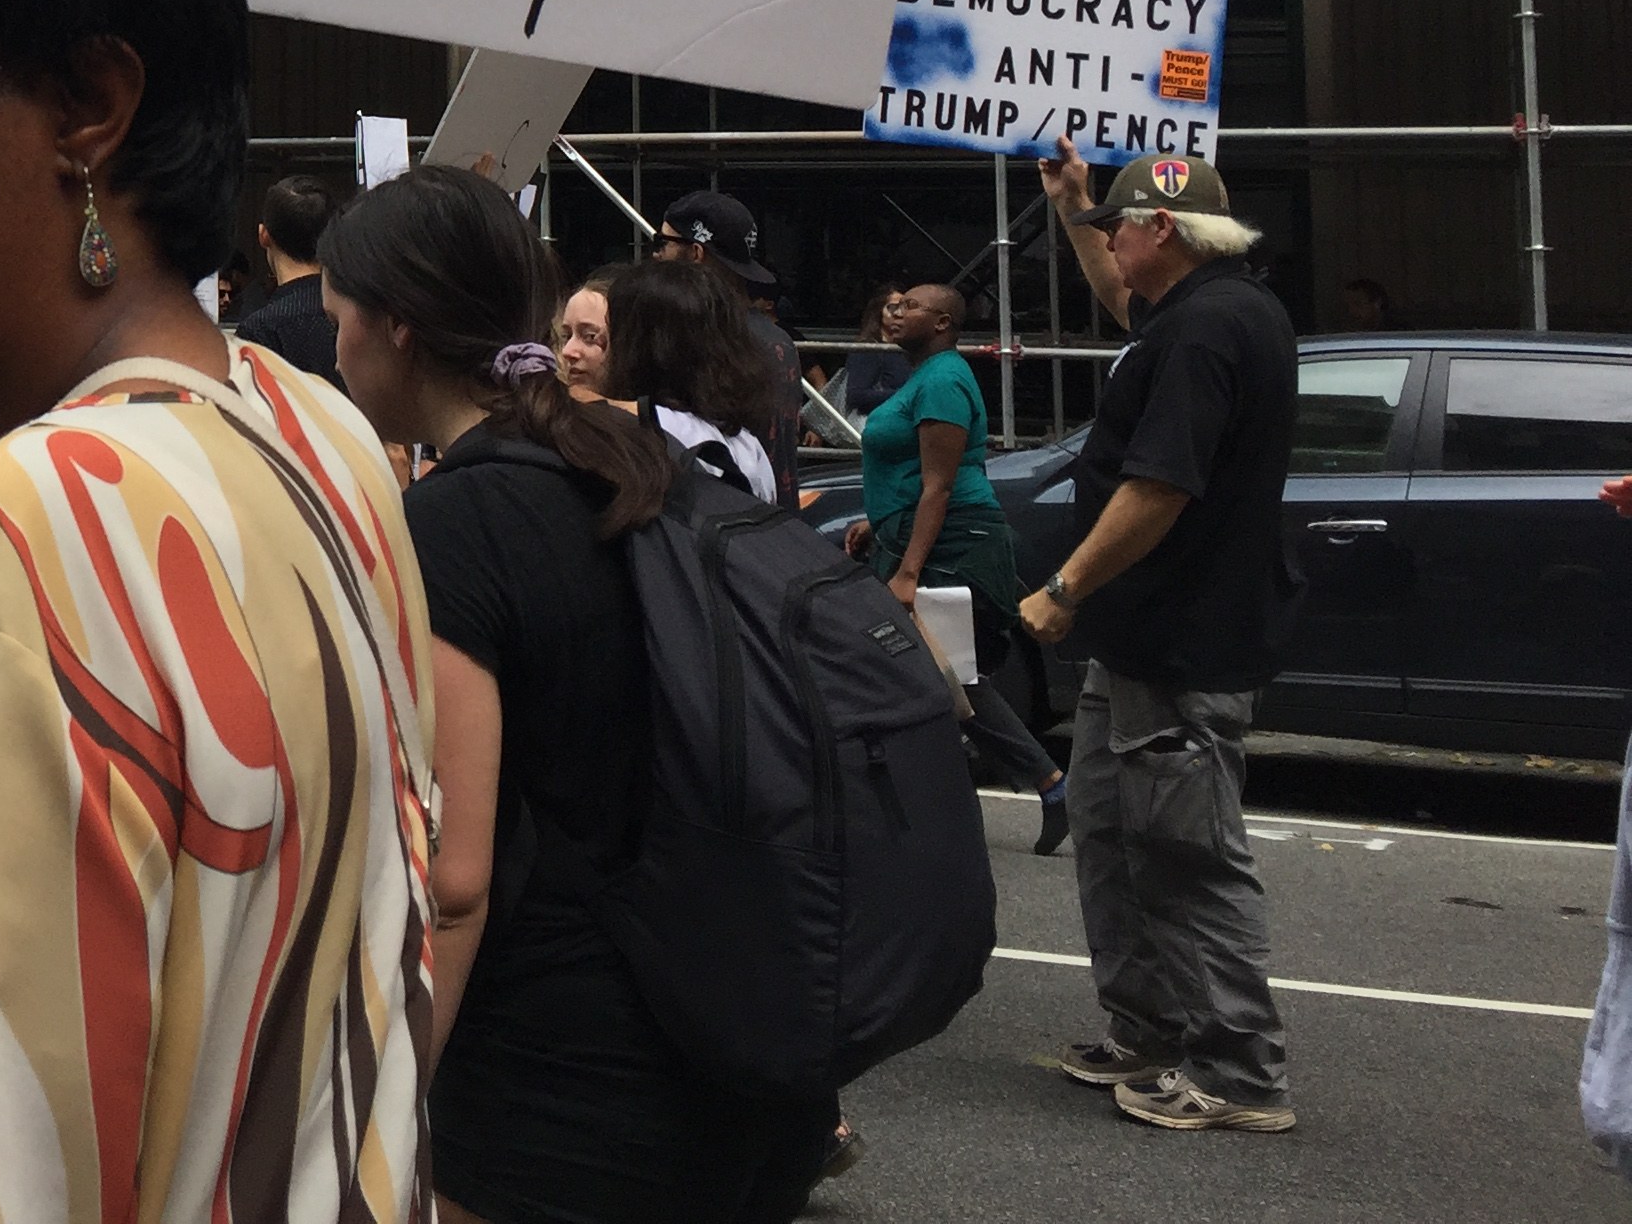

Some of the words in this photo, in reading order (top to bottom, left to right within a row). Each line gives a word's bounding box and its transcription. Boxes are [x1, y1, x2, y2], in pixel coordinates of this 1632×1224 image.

[1165, 50, 1210, 66] Trump/
[1166, 62, 1205, 76] Pence
[1162, 75, 1188, 86] MUST
